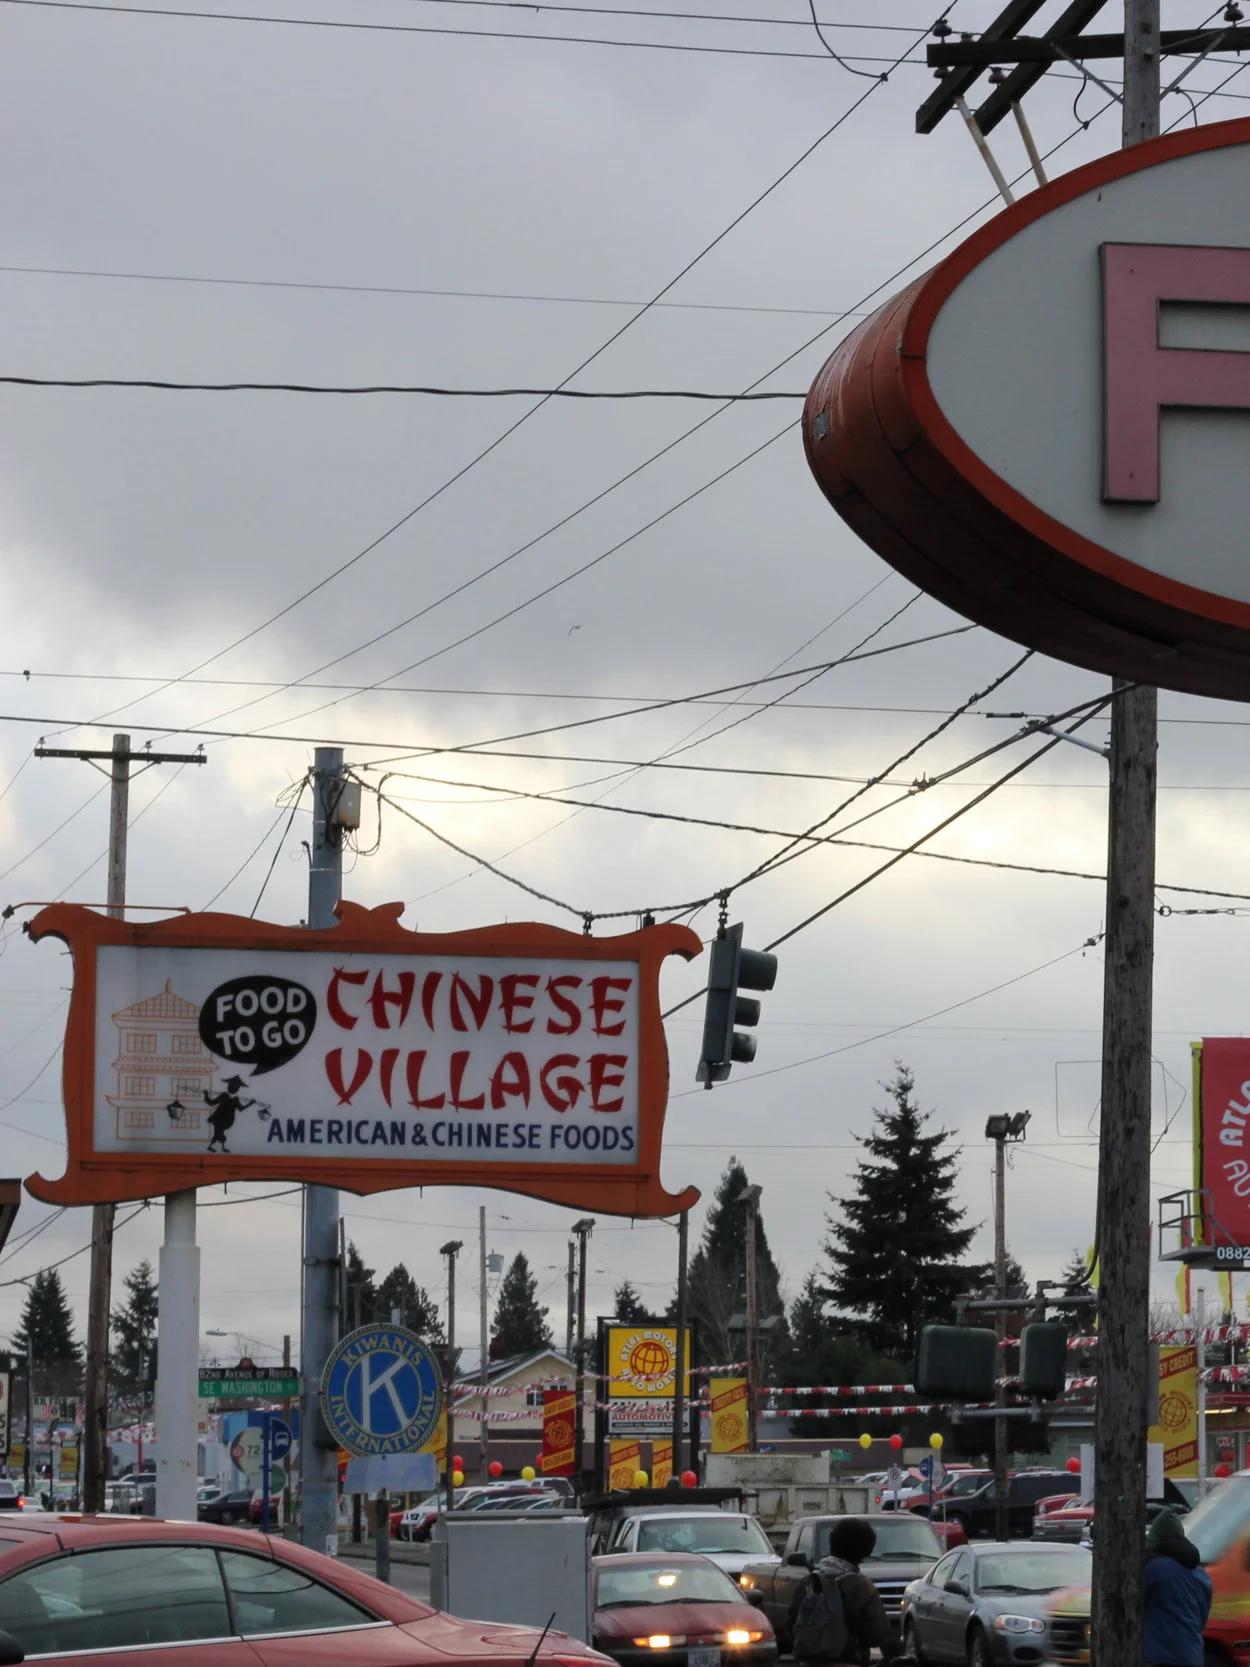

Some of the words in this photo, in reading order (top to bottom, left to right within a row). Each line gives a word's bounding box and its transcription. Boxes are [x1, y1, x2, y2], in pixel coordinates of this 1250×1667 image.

[215, 986, 306, 1021] FOOD
[326, 966, 633, 1037] CHINESE
[216, 1029, 256, 1056] TO
[261, 1019, 306, 1048] GO
[324, 1047, 629, 1113] VILLAGE
[267, 1118, 406, 1147] AMERICAN
[411, 1122, 429, 1147] &
[431, 1120, 542, 1150] CHINESE
[550, 1124, 635, 1152] FOODS
[342, 1334, 423, 1366] KIWANIS
[203, 1381, 216, 1394] SE
[221, 1381, 283, 1394] WASHINGTON
[361, 1354, 413, 1433] K
[331, 1391, 435, 1453] INTERNATIONAL
[612, 1412, 674, 1421] AUTOMOTIV
[247, 1445, 260, 1454] 72
